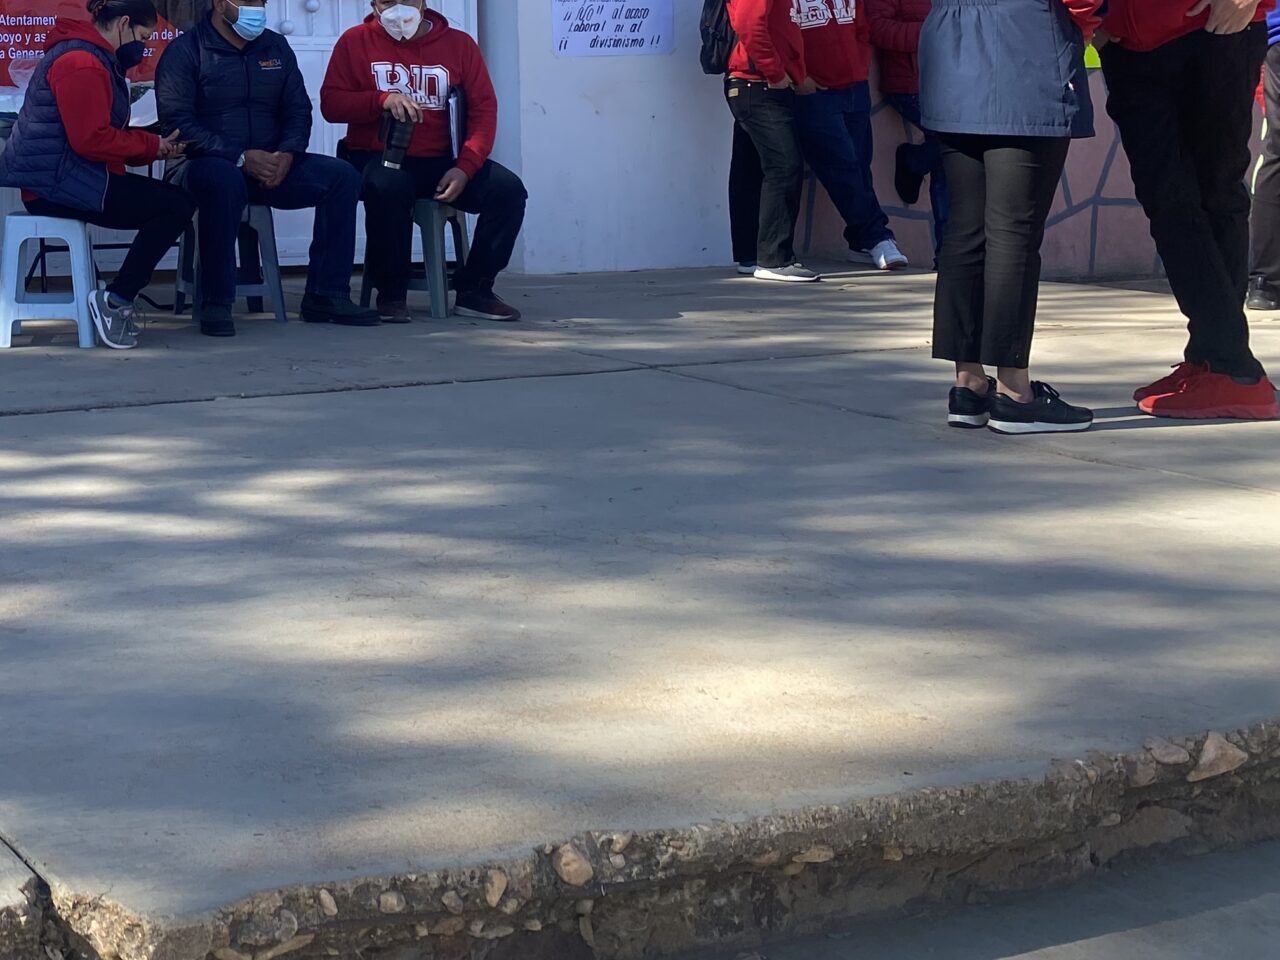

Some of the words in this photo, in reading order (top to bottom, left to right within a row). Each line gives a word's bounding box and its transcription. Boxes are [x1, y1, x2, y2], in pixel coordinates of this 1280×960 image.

[612, 4, 624, 19] al
[625, 7, 649, 19] acoso
[568, 21, 606, 32] Laboral
[630, 21, 643, 32] al
[25, 34, 31, 44] y
[161, 28, 173, 40] de
[8, 48, 45, 60] Genera
